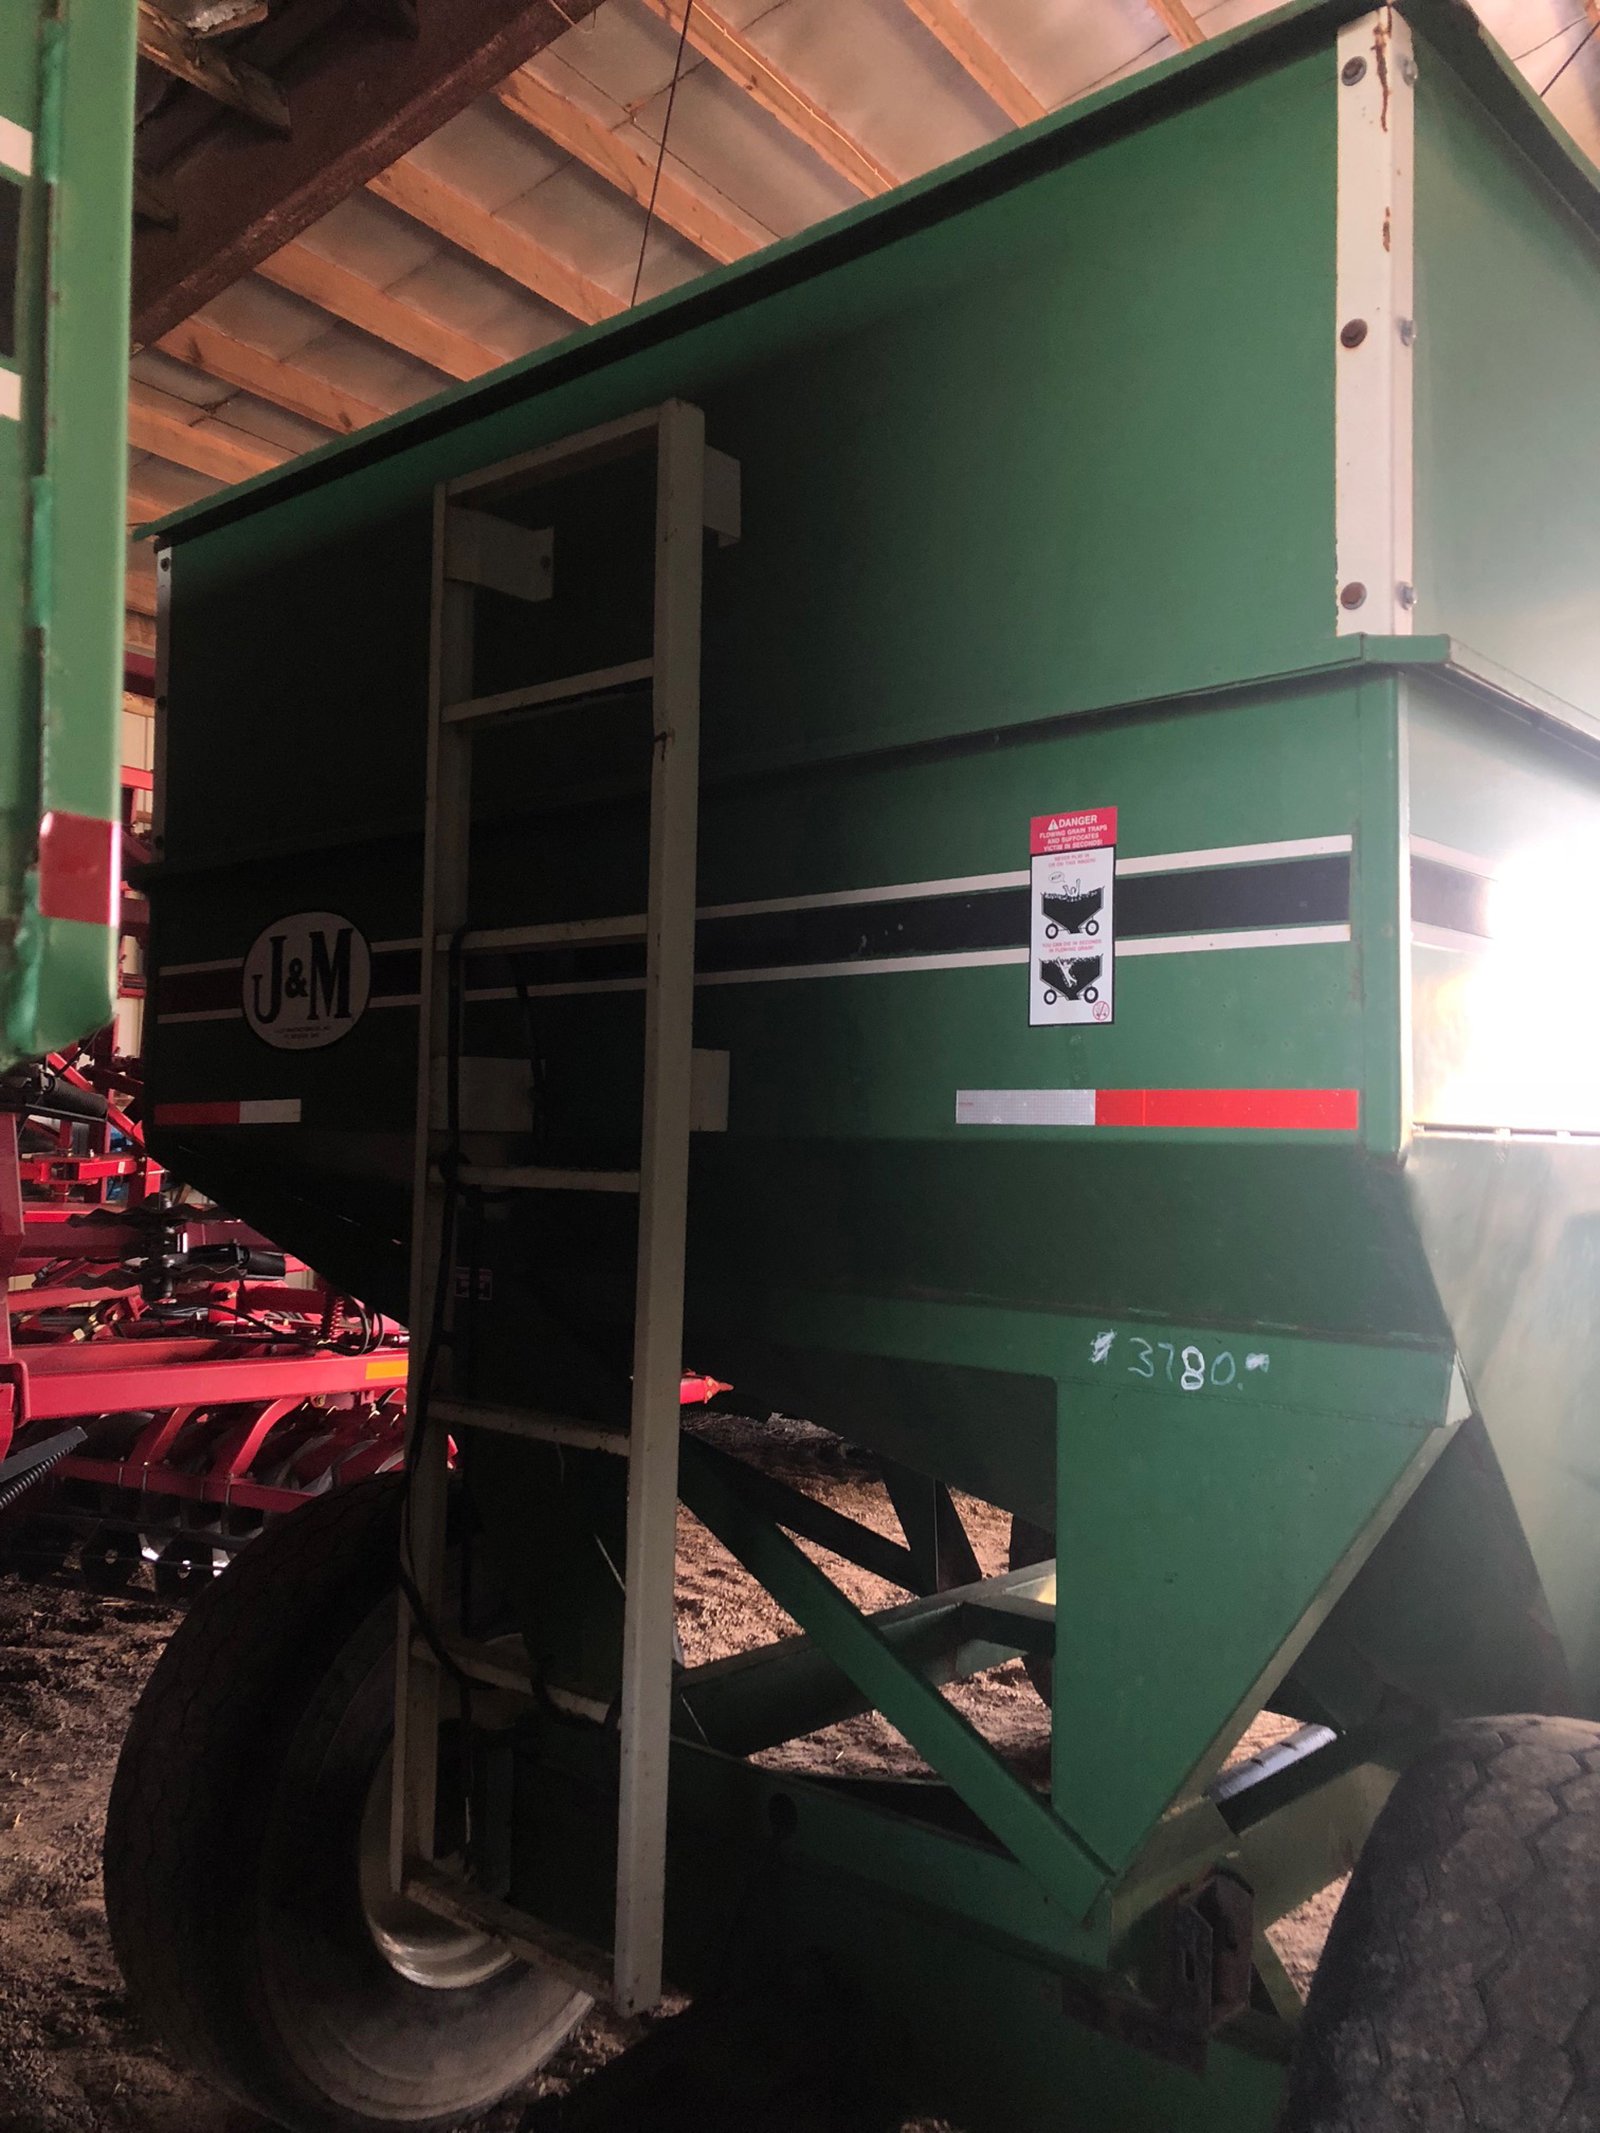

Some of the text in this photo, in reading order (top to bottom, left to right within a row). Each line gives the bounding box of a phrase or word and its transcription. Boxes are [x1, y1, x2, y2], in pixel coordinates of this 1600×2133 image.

[1059, 815, 1098, 828] DANGER
[1039, 824, 1108, 839] FLOWING GRAIN TRAPS
[1061, 832, 1099, 843] SUFFOCATES
[1043, 844, 1063, 852] VICTIM
[252, 928, 354, 1024] J&M
